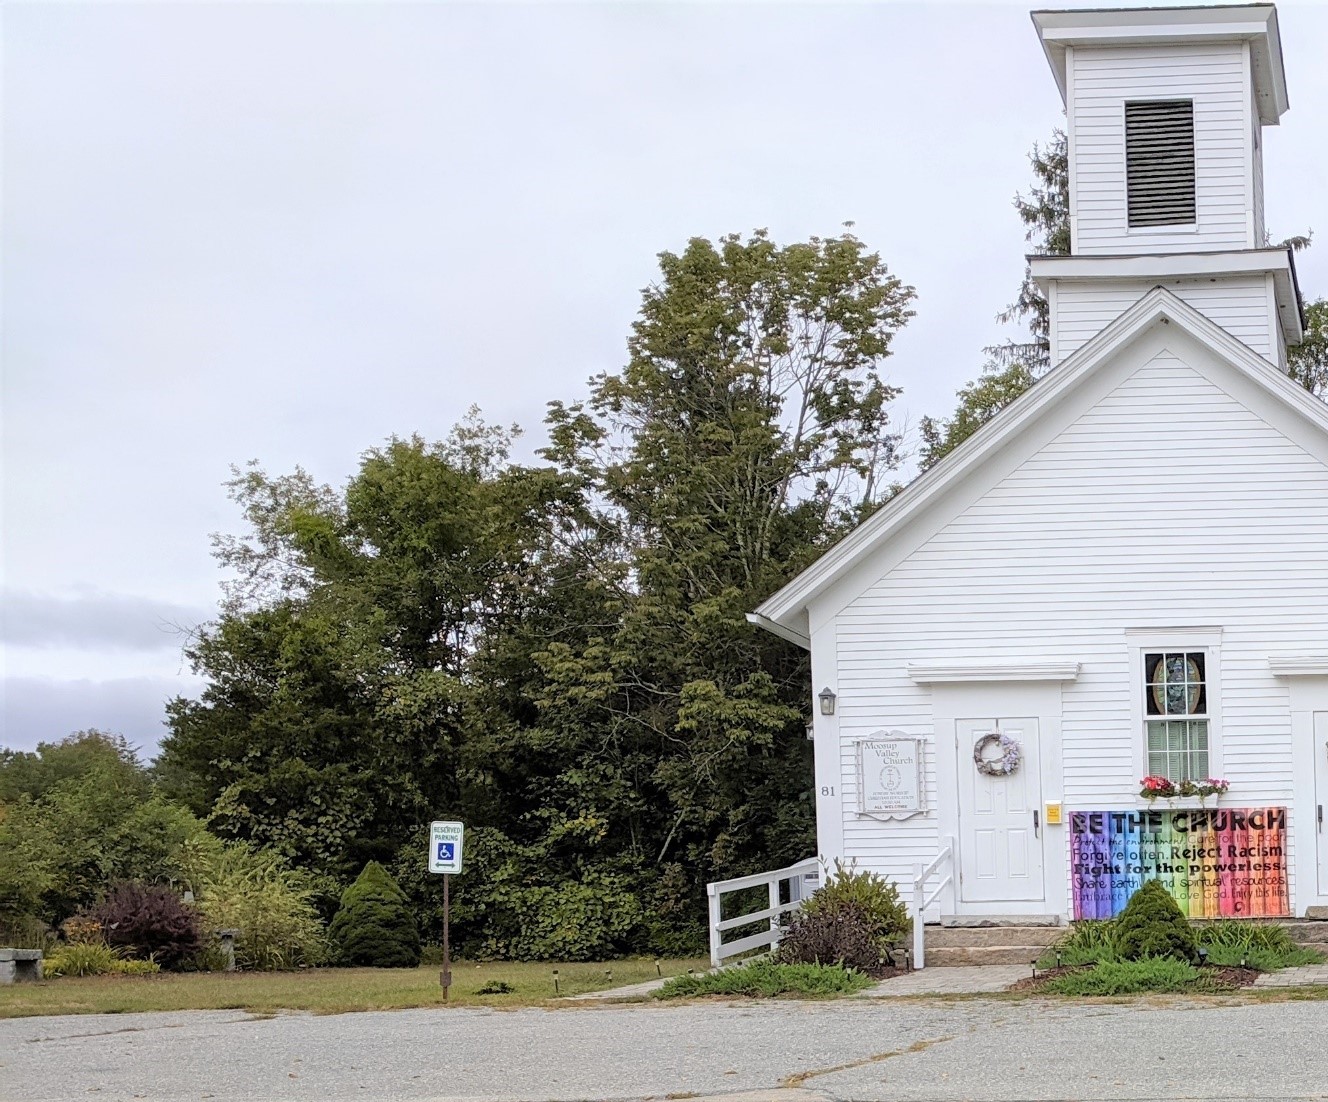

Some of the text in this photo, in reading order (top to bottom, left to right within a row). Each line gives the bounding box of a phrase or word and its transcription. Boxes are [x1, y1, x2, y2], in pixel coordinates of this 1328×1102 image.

[864, 742, 898, 750] Moosup
[883, 756, 914, 765] Church
[821, 786, 835, 797] 81
[1072, 809, 1285, 833] BE THE CHURCH
[1073, 834, 1105, 846] Protect
[1109, 834, 1122, 845] the
[1187, 834, 1216, 844] Care
[1217, 833, 1231, 843] for
[1237, 832, 1254, 843] the
[1073, 848, 1124, 864] Forgive
[1171, 844, 1222, 861] Reject
[1228, 843, 1286, 858] Racism.
[1074, 860, 1287, 877] Fight for the powerless.
[1074, 877, 1107, 889] Share
[1180, 876, 1225, 888] spiritual
[1174, 889, 1200, 900] Love
[1203, 889, 1230, 900] God.
[1256, 886, 1270, 898] this
